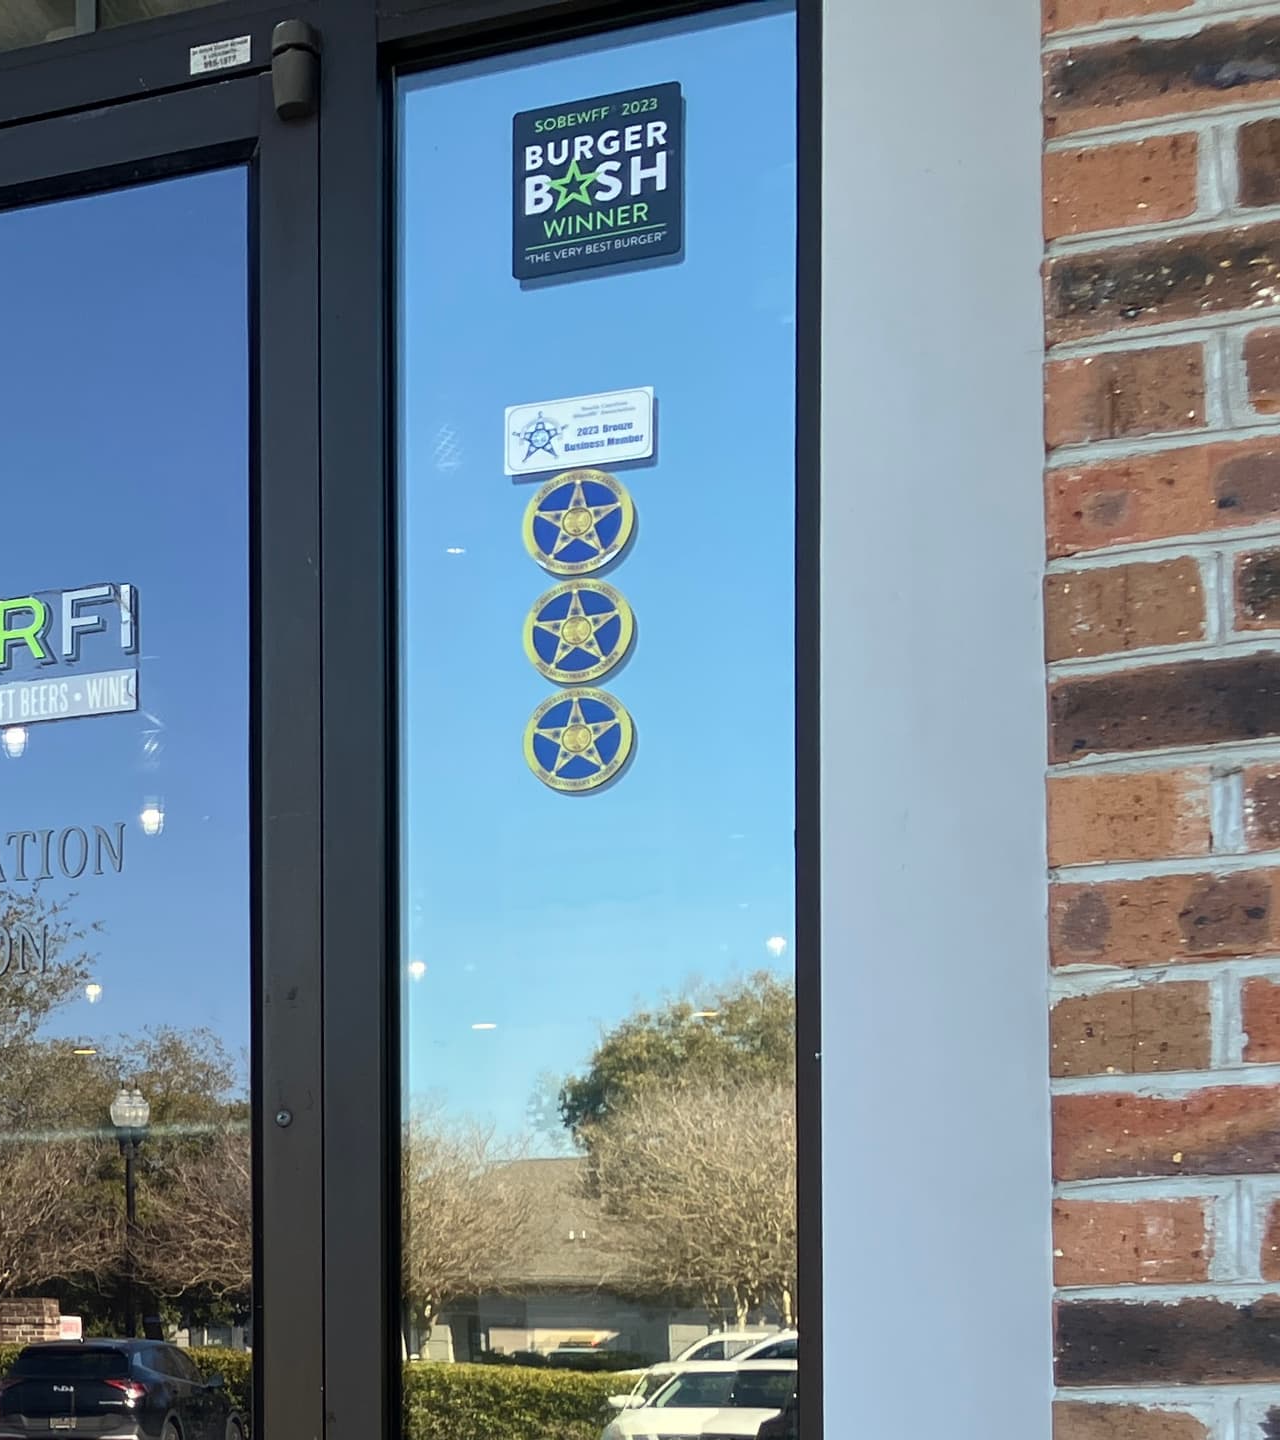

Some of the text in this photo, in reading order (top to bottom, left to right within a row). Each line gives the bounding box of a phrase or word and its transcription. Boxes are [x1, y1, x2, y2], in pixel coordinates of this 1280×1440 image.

[621, 97, 658, 117] 2023
[524, 120, 668, 172] BURGER
[524, 150, 667, 216] BSH
[543, 202, 649, 240] WINNER
[553, 246, 583, 261] VERY
[585, 239, 613, 255] BEST
[564, 433, 644, 453] Business Member
[576, 421, 633, 437] 2023 Bronze
[20, 683, 69, 717] BEERS
[87, 675, 129, 708] WINE
